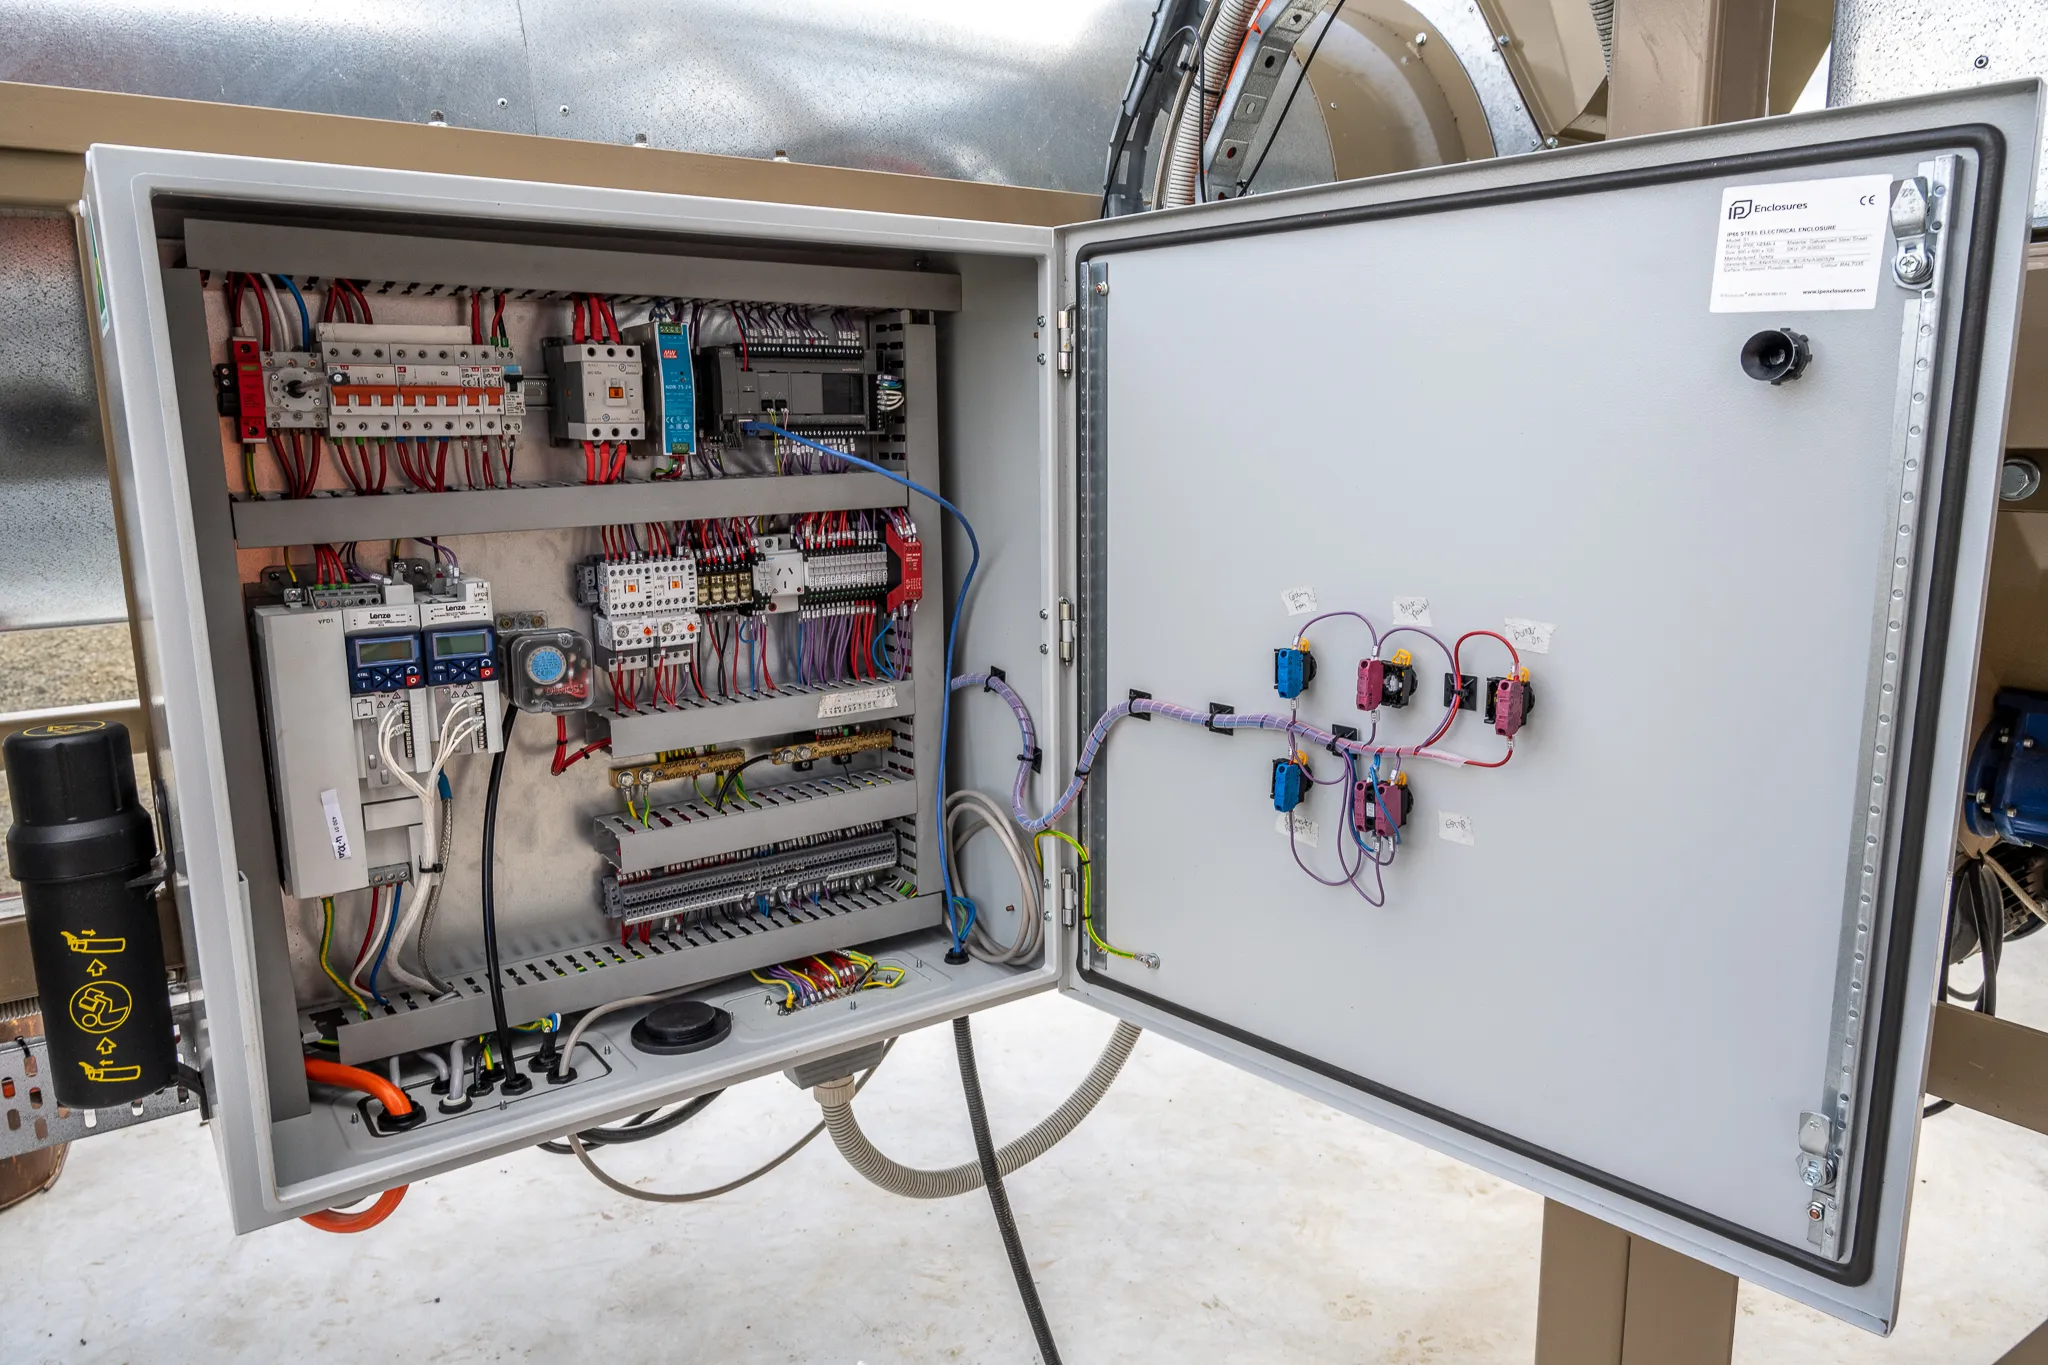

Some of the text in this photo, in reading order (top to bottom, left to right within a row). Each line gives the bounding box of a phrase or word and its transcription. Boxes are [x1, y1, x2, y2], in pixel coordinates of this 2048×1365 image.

[1754, 202, 1808, 213] Enclosures
[1759, 227, 1796, 235] ELECTRICAL
[1798, 224, 1837, 233] ENCLOSURE
[1802, 287, 1866, 295] www.ipenclosures.com
[445, 604, 467, 612] Lenze
[369, 612, 392, 620] Lenze
